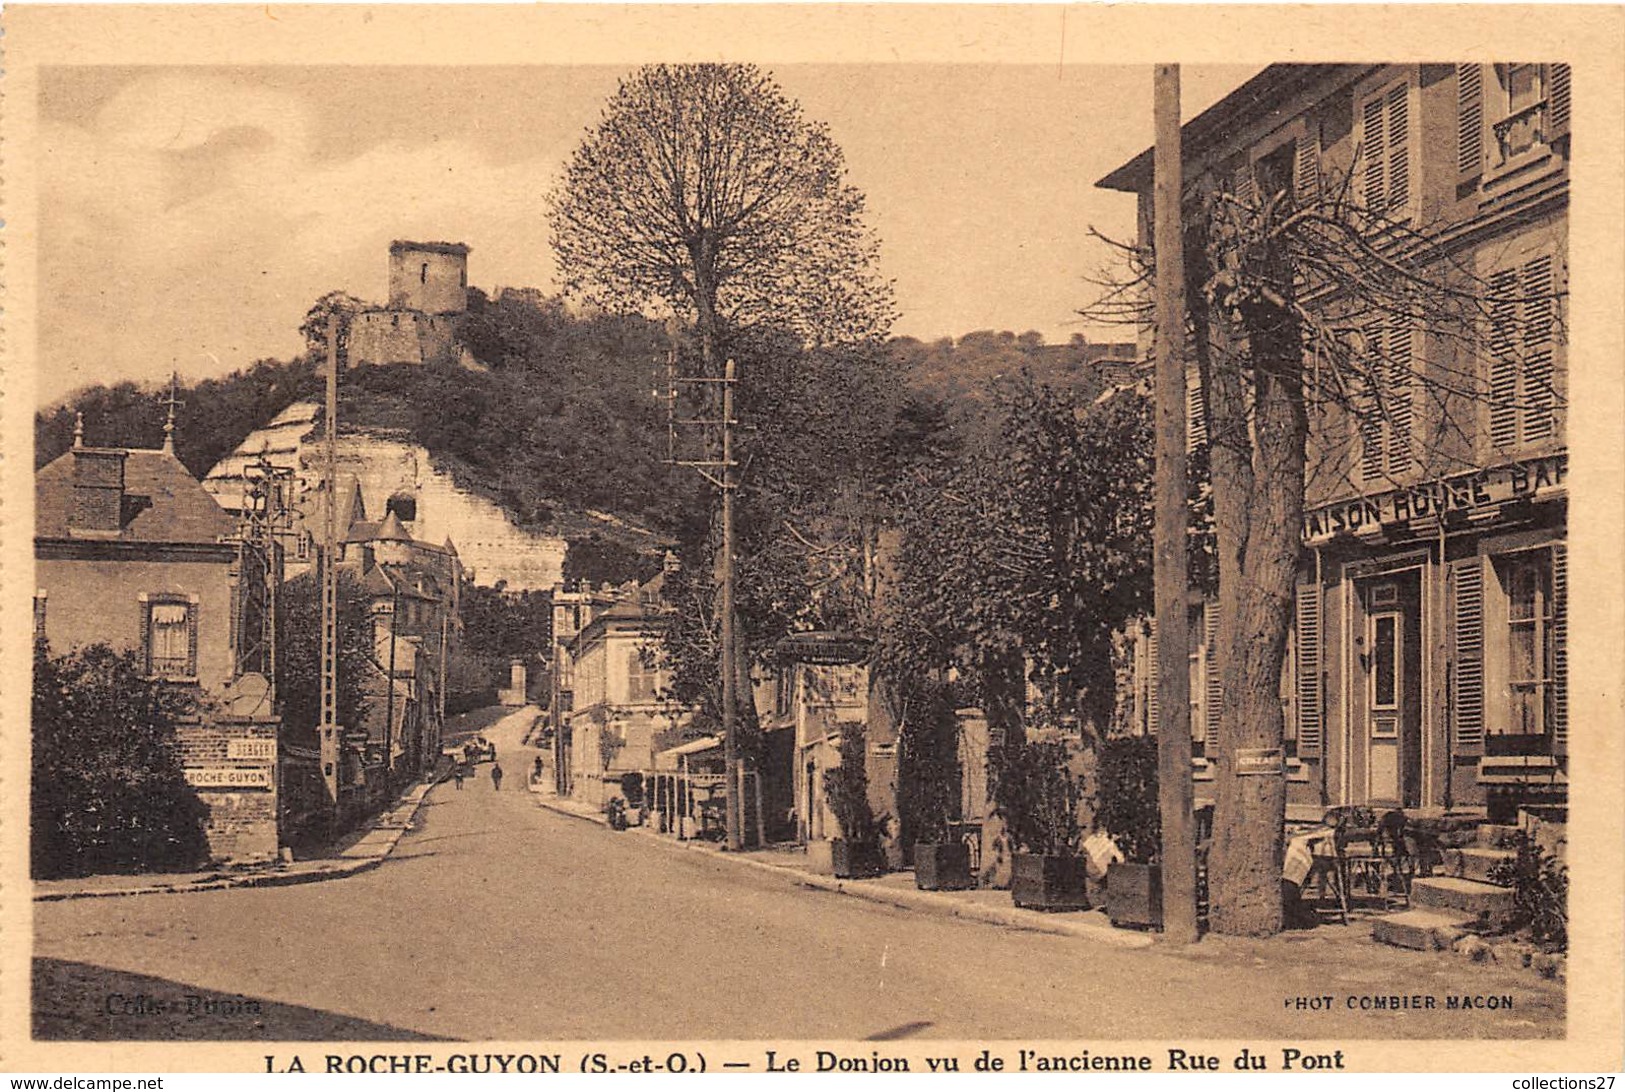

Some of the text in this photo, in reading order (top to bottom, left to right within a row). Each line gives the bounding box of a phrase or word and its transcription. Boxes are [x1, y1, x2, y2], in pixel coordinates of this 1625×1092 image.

[1347, 995, 1436, 1011] COMBIER
[1445, 995, 1513, 1011] MACON
[265, 1055, 305, 1073] LA
[325, 1055, 561, 1073] ROCHE-GUYON
[580, 1053, 707, 1073] (S.-et-O.)
[766, 1051, 800, 1073] Le
[816, 1051, 910, 1073] Donjon
[926, 1058, 960, 1072] vu
[975, 1050, 1004, 1072] de
[1020, 1049, 1152, 1072] l'ancienne
[1168, 1049, 1220, 1071] Rue
[1234, 1048, 1267, 1071] du
[1282, 1048, 1345, 1070] Pont
